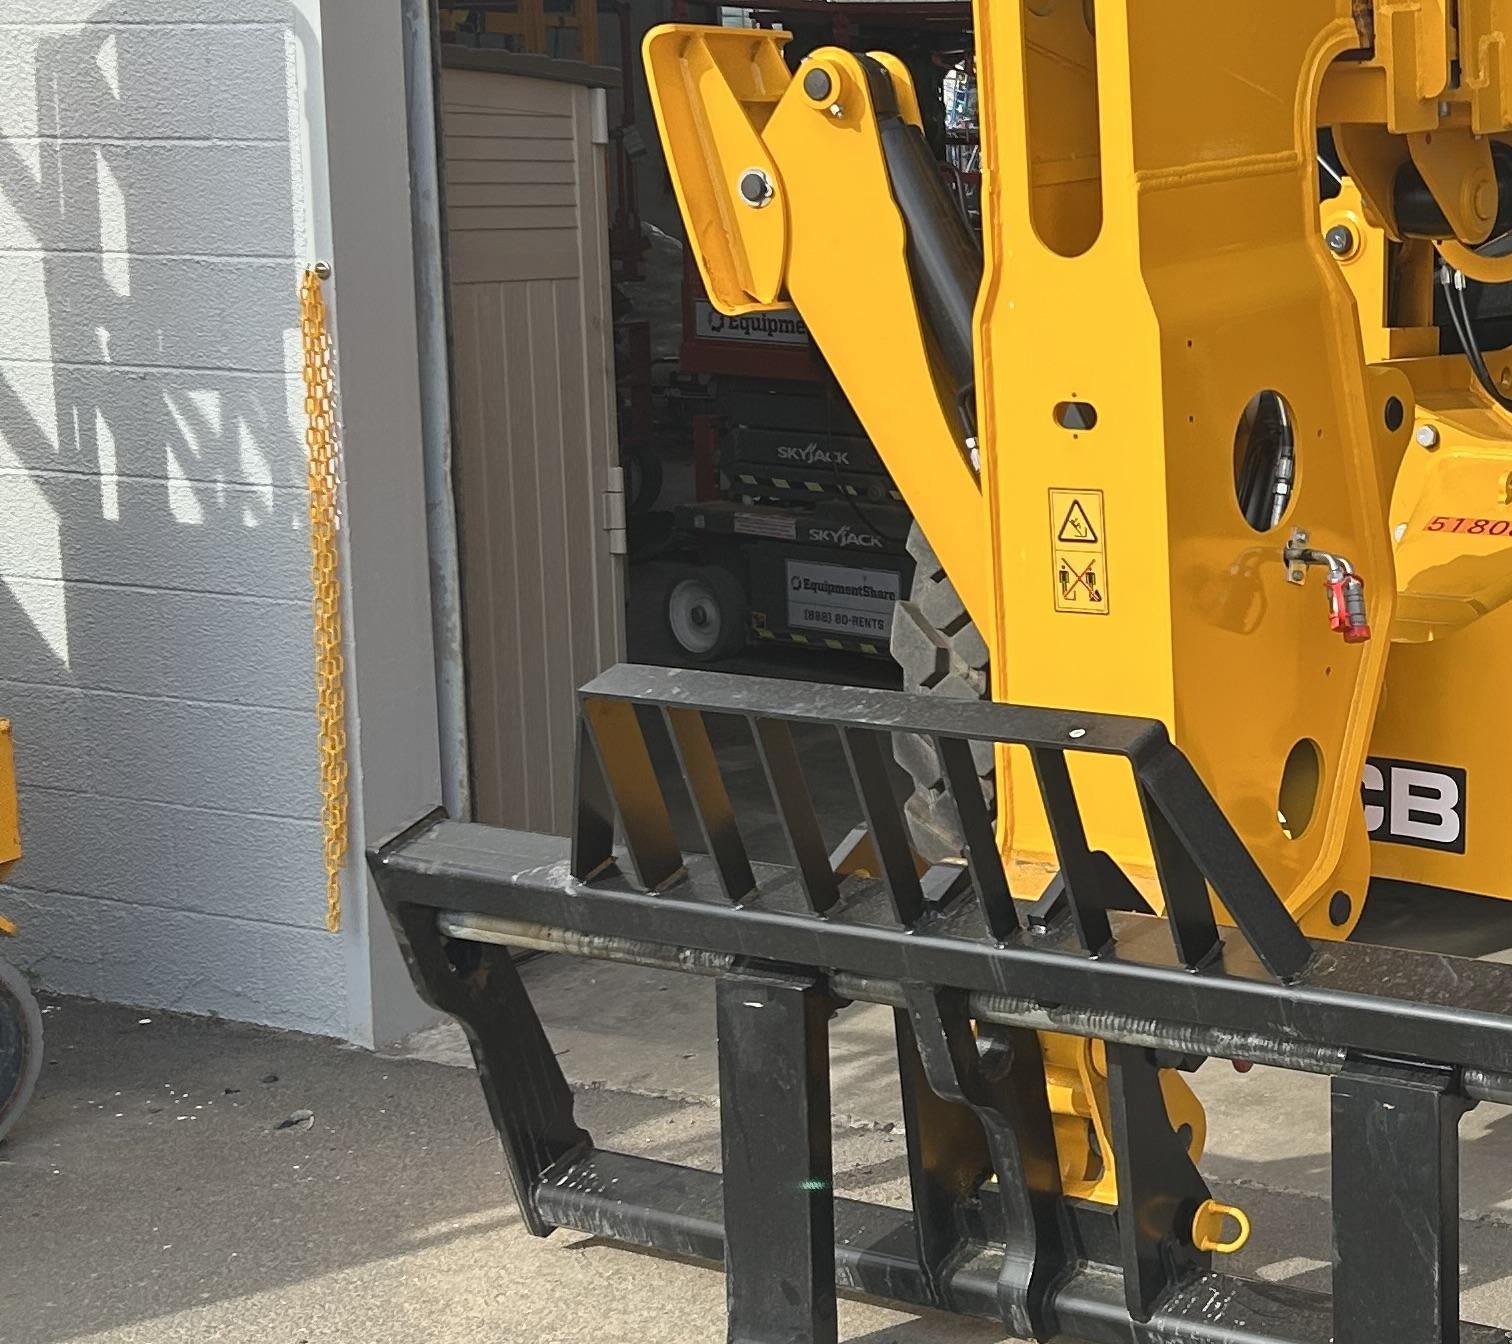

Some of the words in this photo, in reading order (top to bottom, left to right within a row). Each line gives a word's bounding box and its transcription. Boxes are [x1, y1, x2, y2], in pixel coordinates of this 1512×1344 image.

[777, 442, 849, 465] SKYJACK
[808, 525, 883, 548] SKYJACK
[803, 577, 896, 601] EquipmentShare
